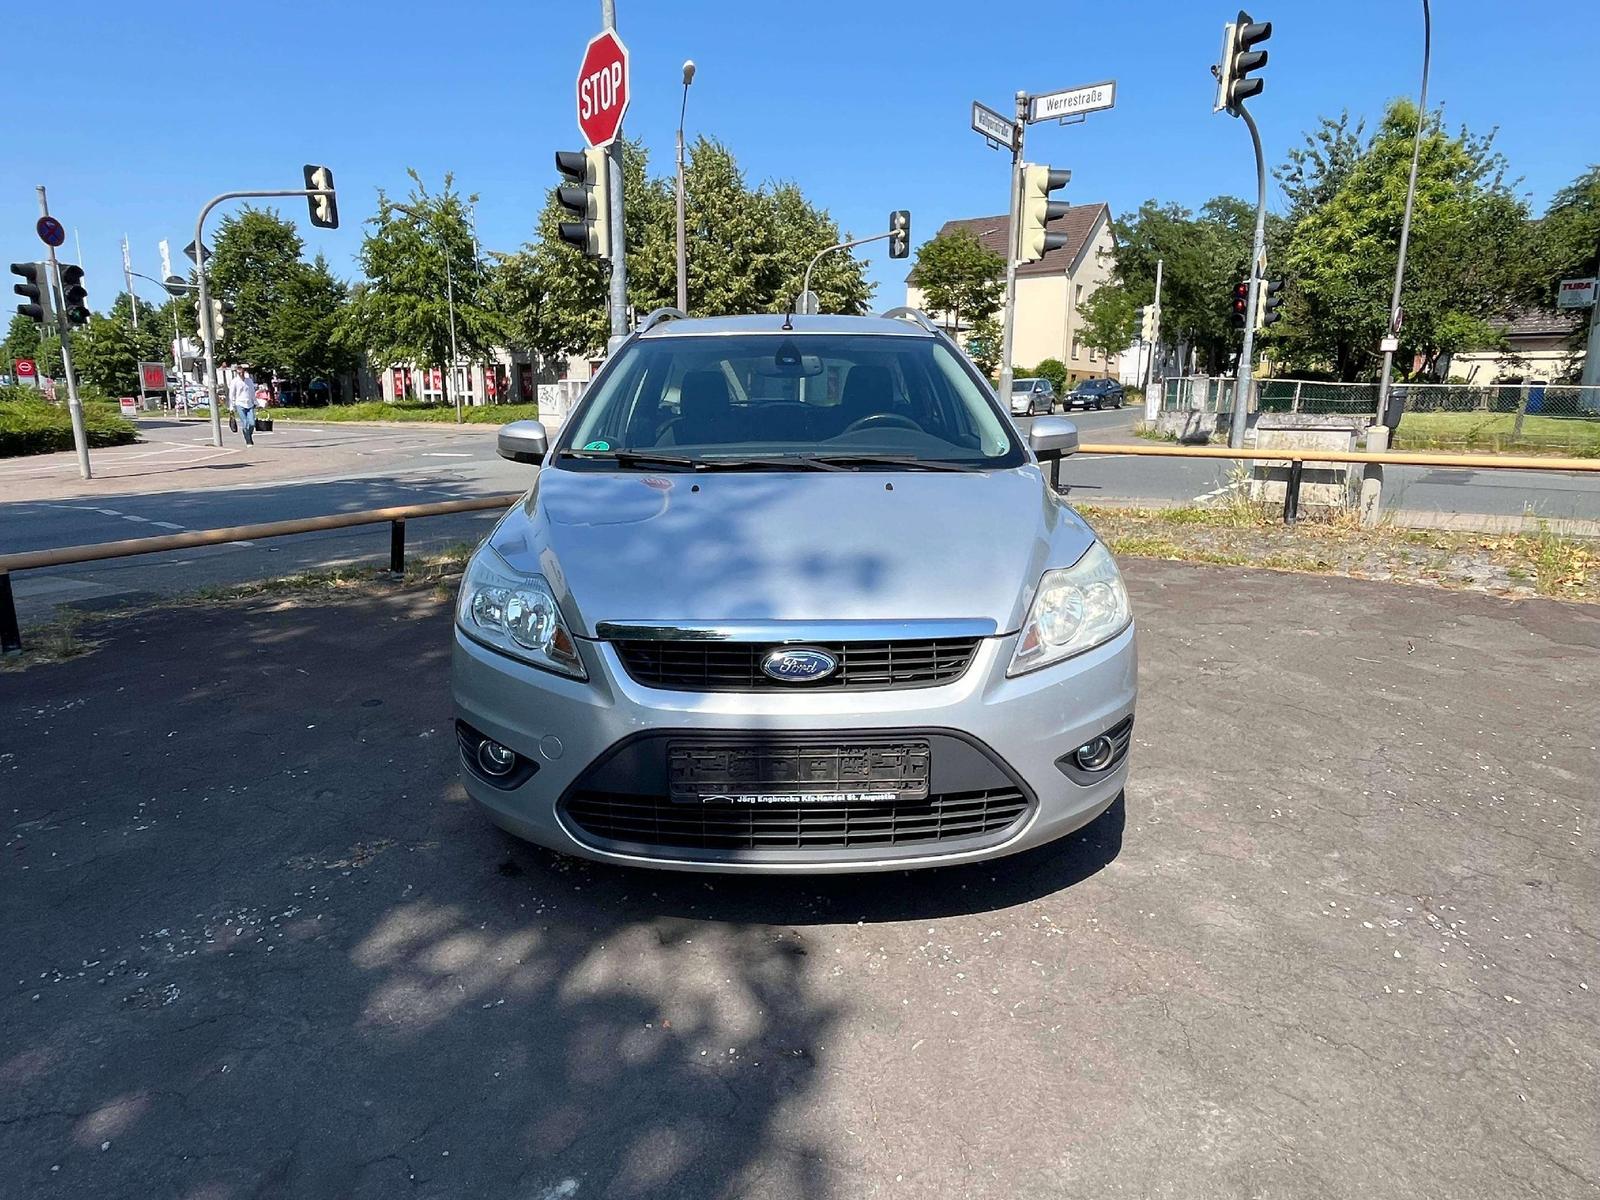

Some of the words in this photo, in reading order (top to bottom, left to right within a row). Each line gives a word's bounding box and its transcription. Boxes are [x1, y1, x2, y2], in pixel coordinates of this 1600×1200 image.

[581, 61, 622, 120] STOP
[1046, 90, 1102, 111] Werrestraße
[779, 657, 818, 673] Ford
[737, 794, 756, 804] Jörg
[859, 792, 896, 802] Augustin
